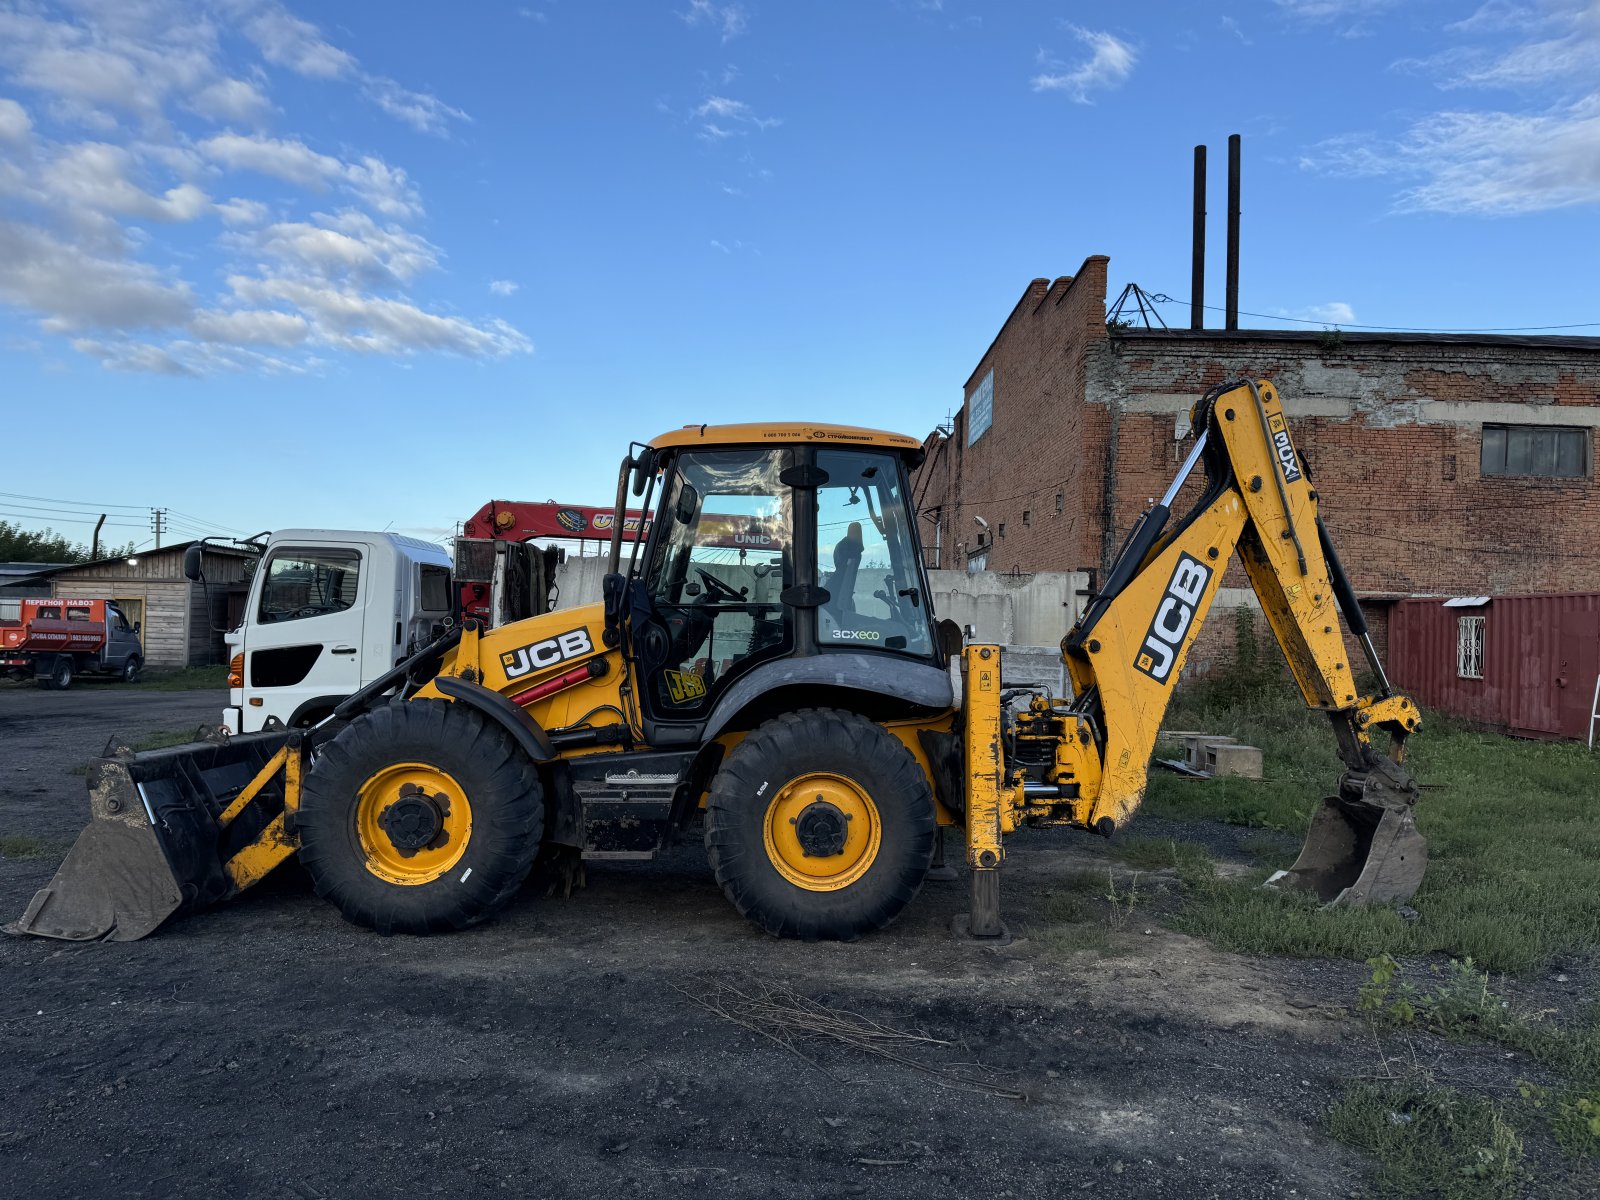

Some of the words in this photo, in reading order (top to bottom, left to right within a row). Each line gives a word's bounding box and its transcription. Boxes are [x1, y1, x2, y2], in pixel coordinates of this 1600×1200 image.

[1274, 431, 1299, 475] 3CX
[734, 534, 771, 545] UNIC
[1145, 558, 1208, 678] JCB
[506, 630, 592, 677] JCB
[671, 672, 705, 700] JCB
